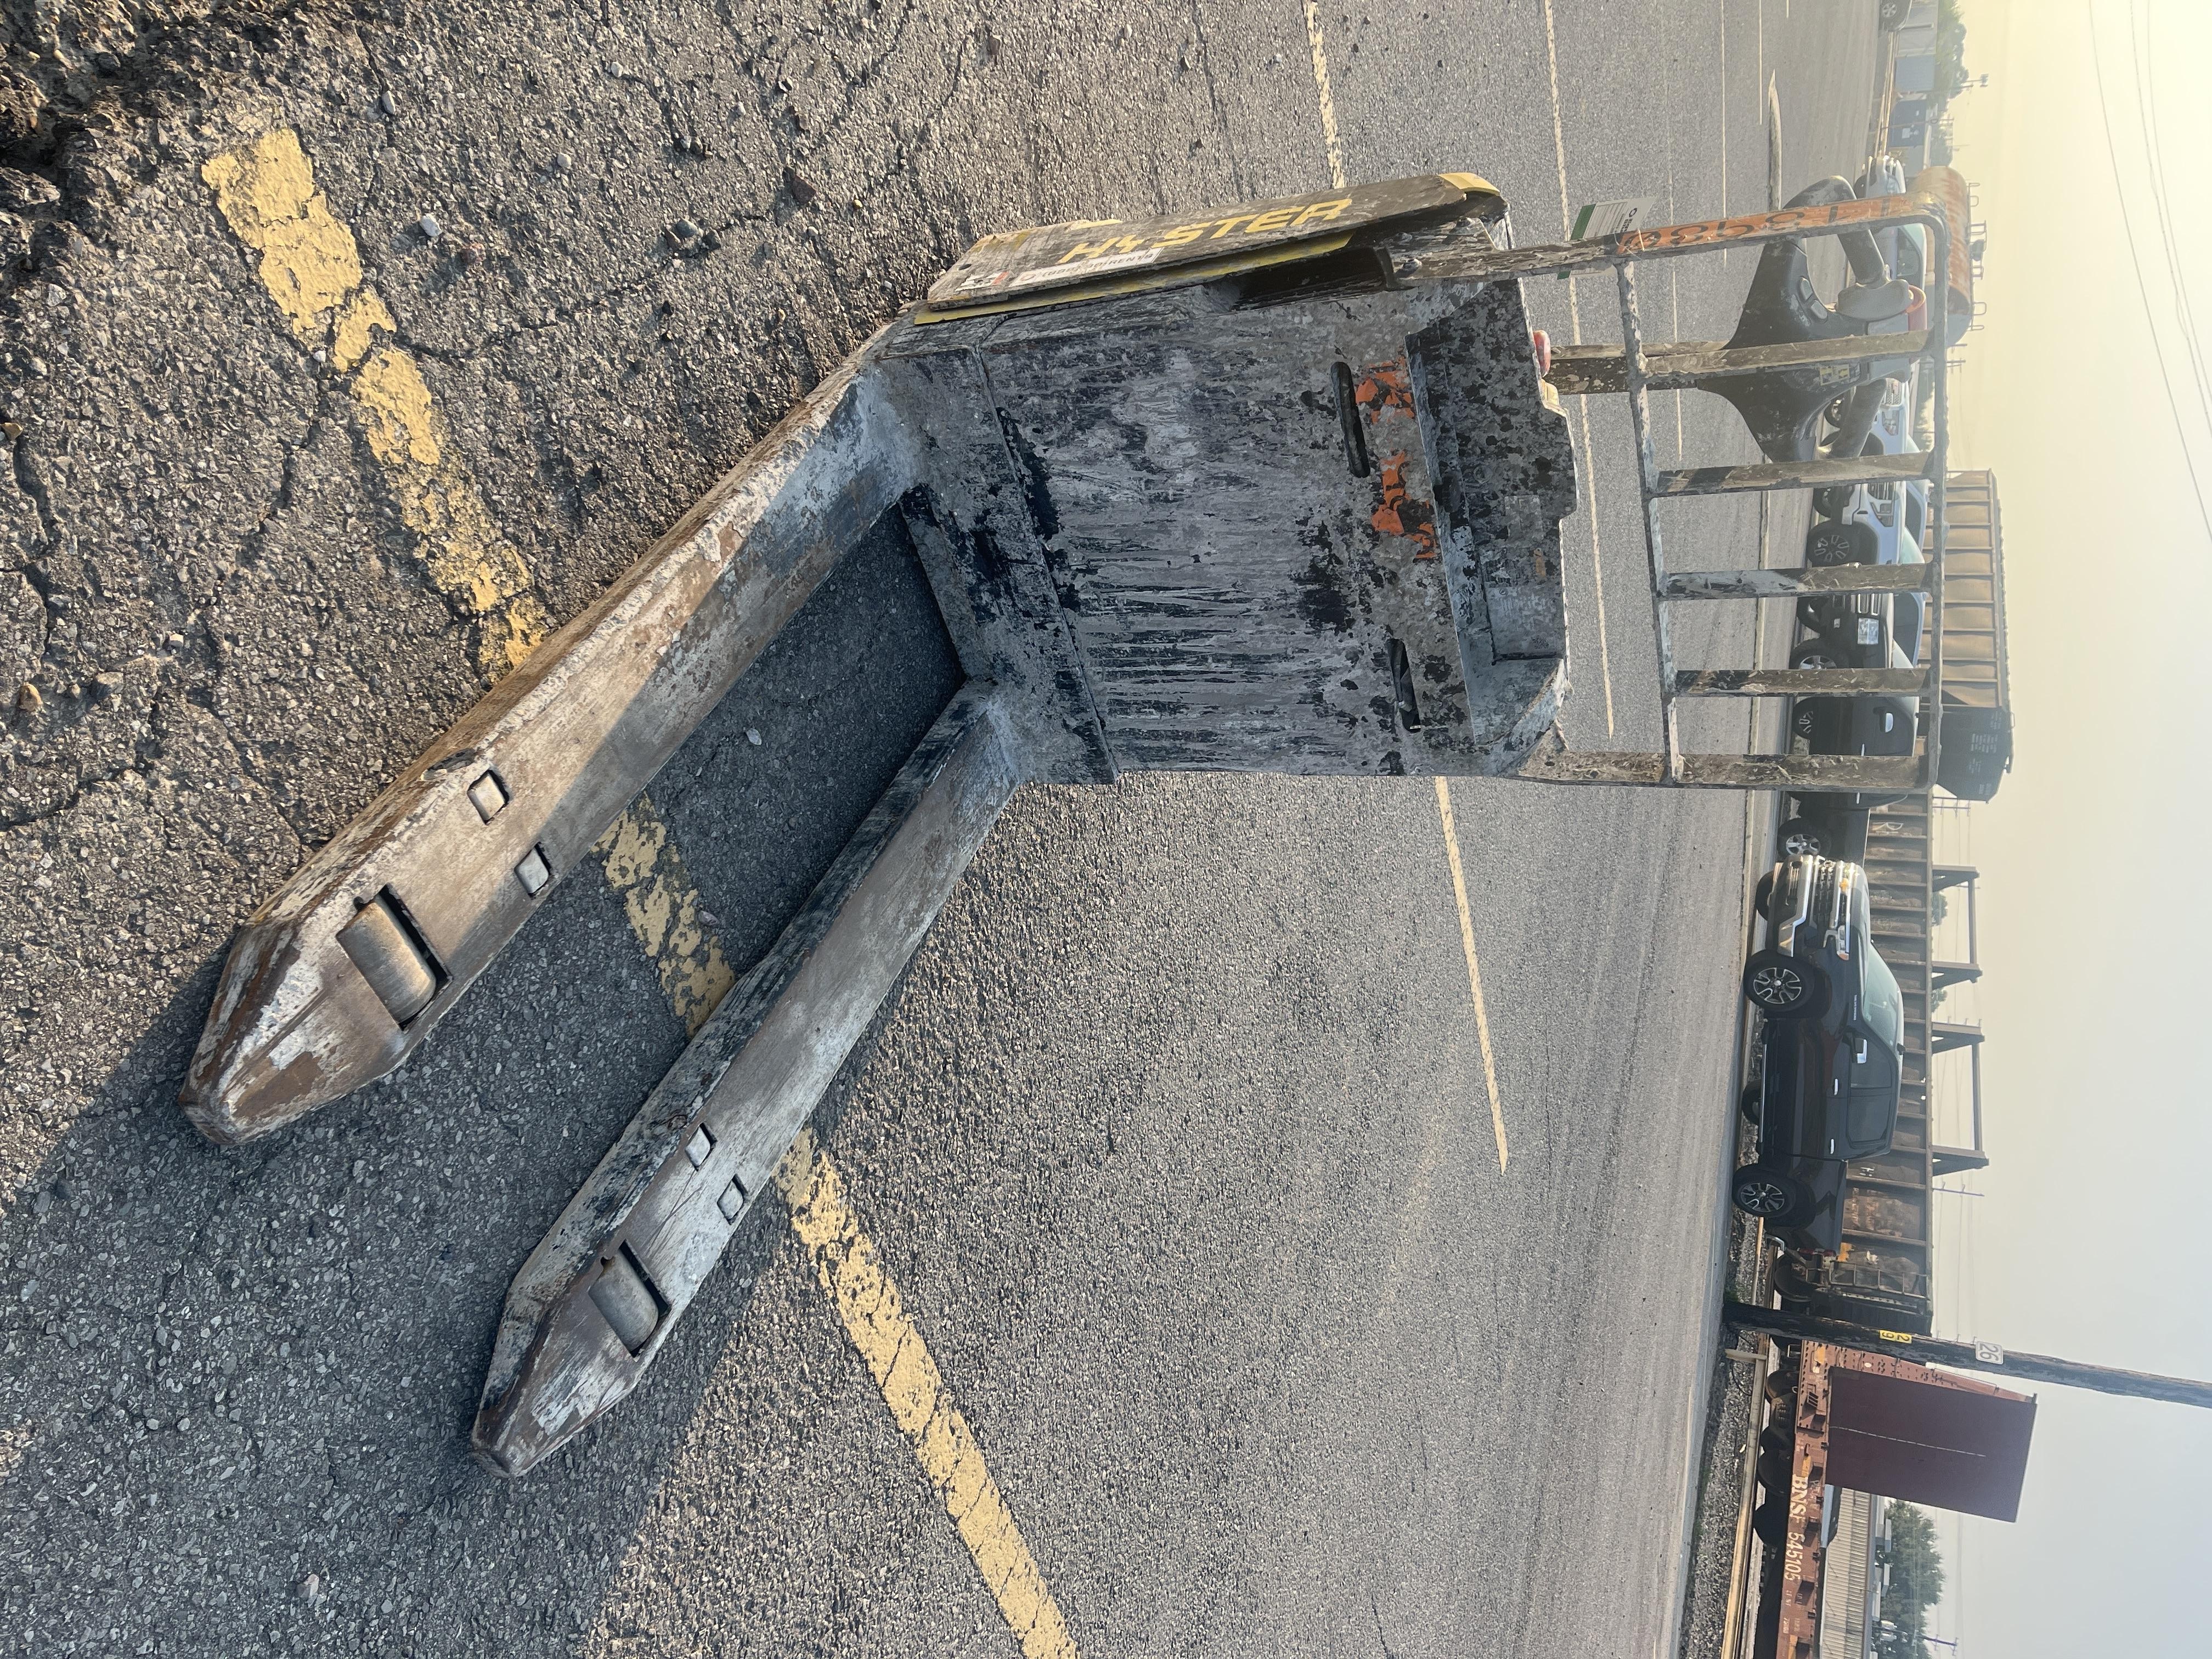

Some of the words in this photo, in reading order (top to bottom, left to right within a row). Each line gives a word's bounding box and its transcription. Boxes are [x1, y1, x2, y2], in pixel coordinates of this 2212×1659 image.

[1056, 198, 1353, 264] HYSTER
[1979, 1343, 1999, 1361] 26
[1790, 1474, 1808, 1523] BNSF
[1785, 1532, 1805, 1581] 545105
